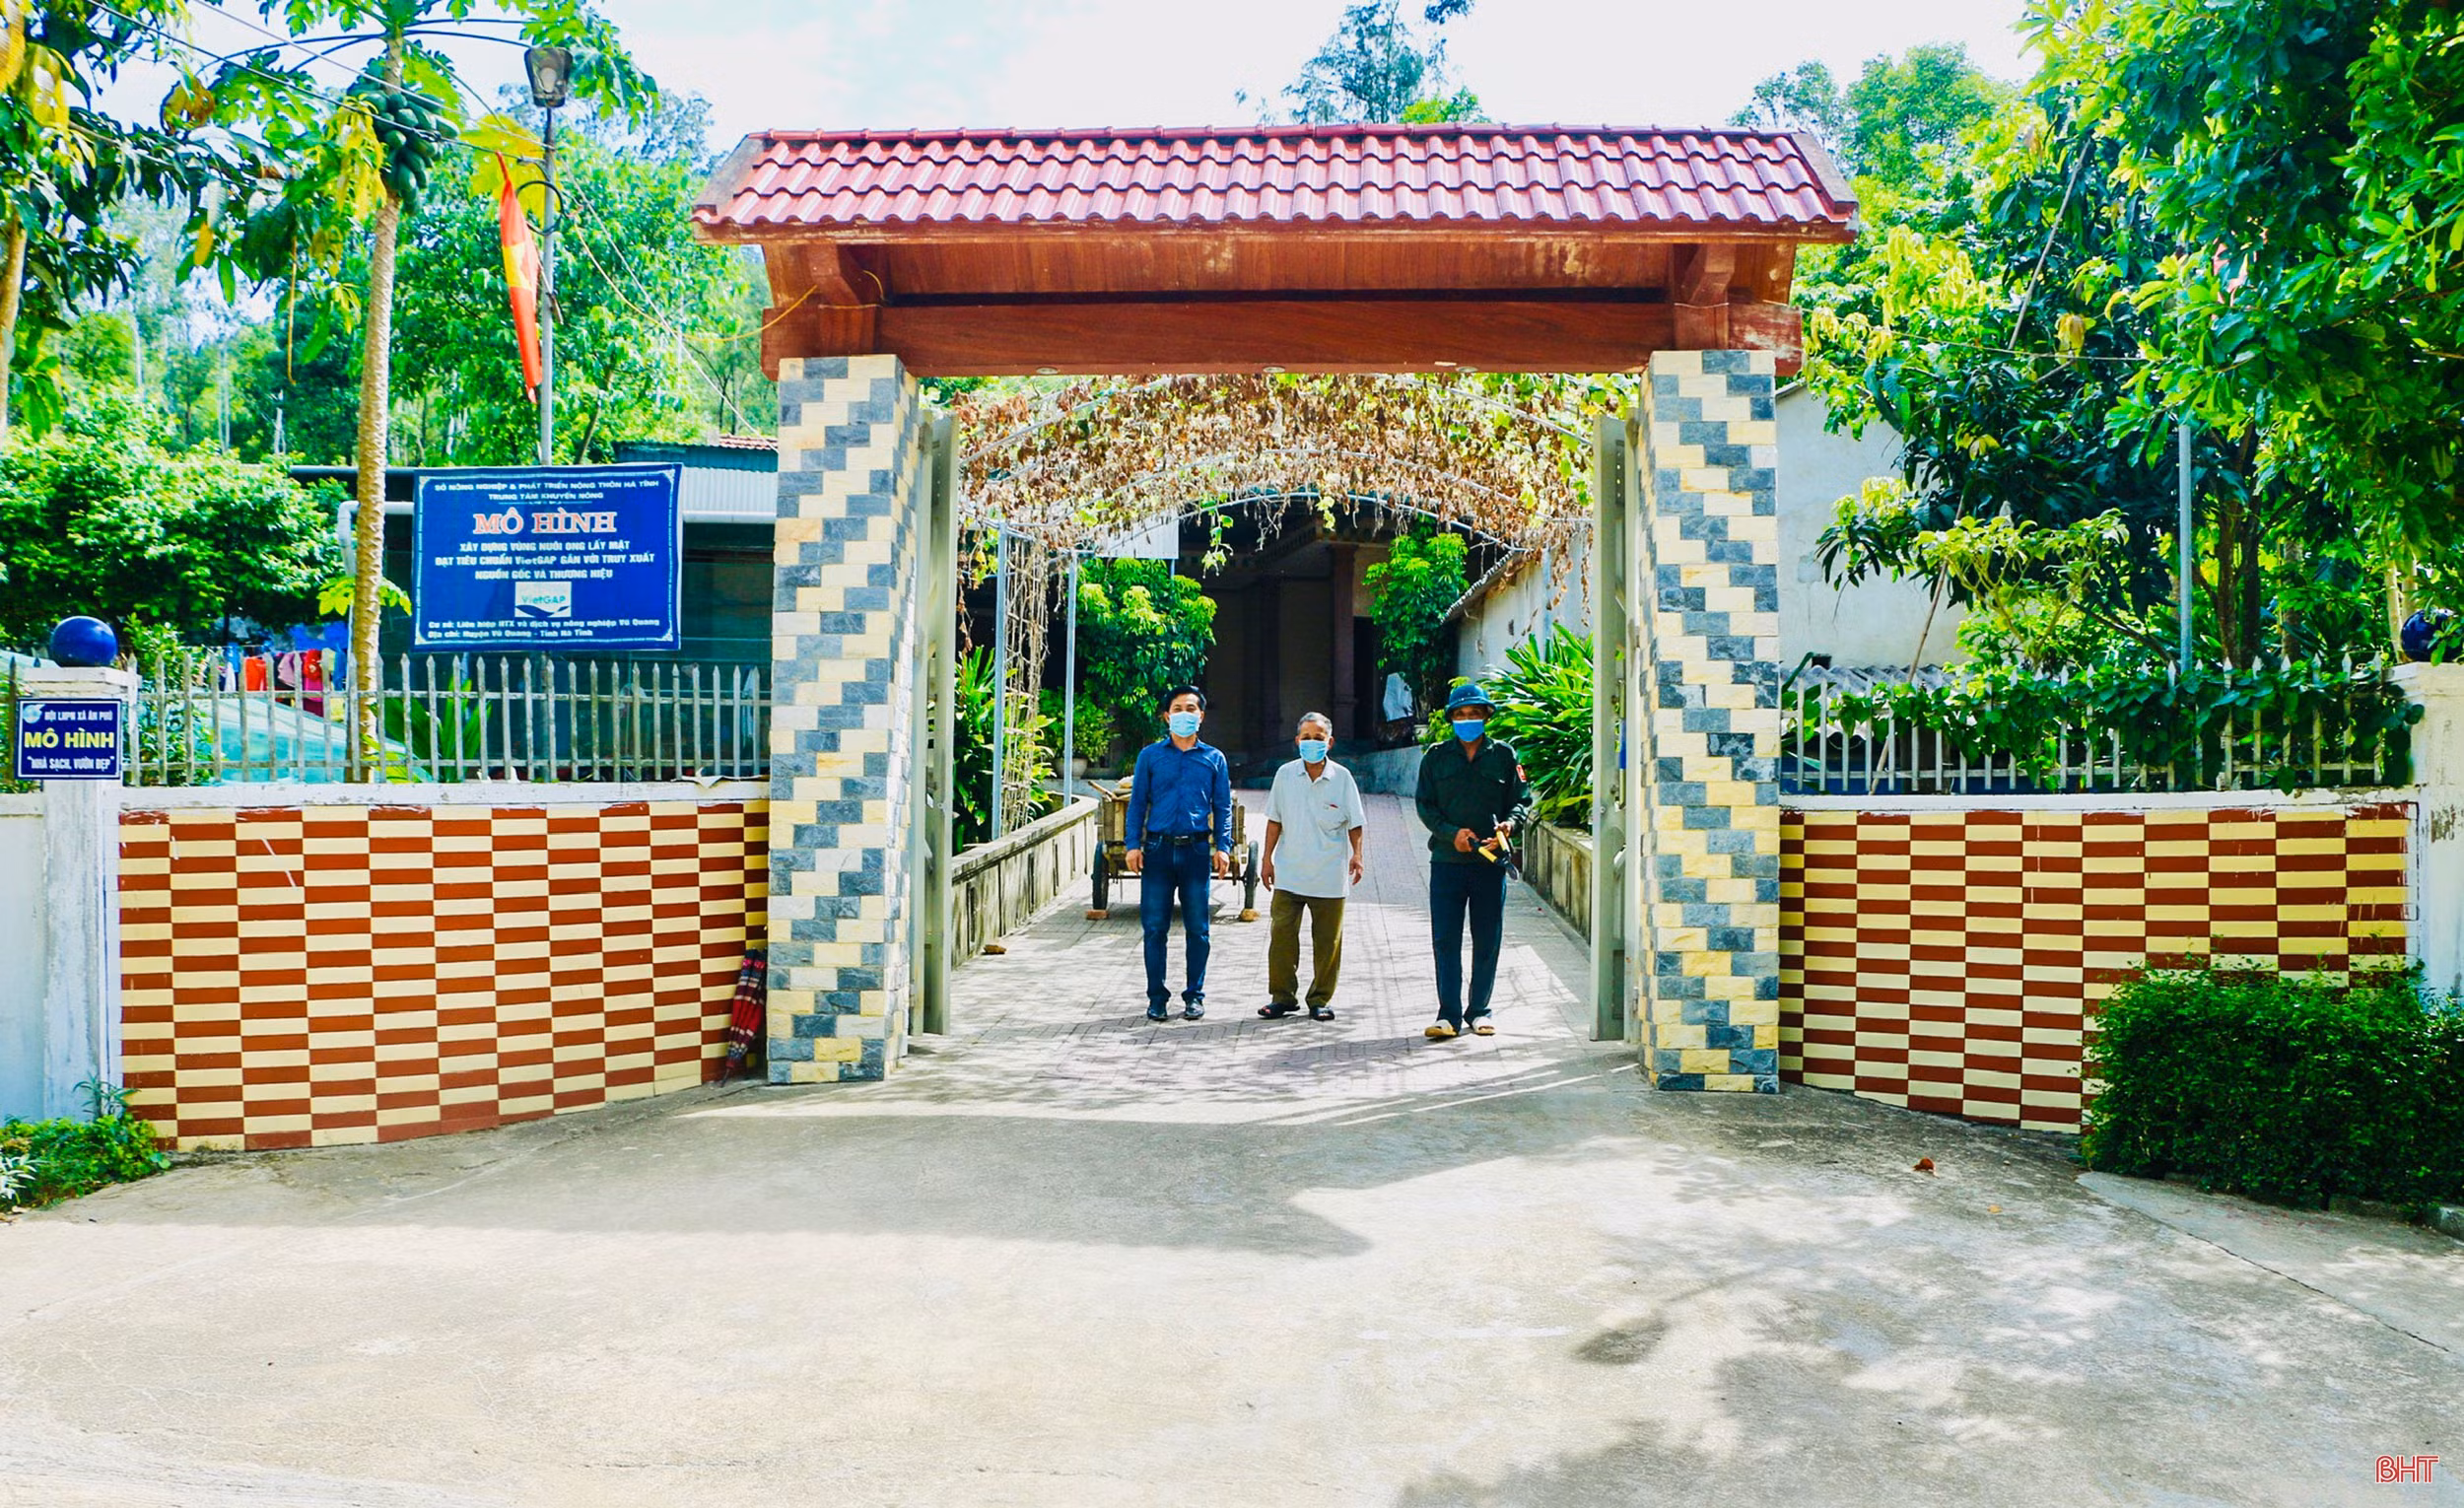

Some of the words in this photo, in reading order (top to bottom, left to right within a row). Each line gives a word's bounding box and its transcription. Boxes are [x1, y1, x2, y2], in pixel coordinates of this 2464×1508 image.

[473, 507, 524, 534] MÔ
[531, 507, 617, 533] HÌNH
[460, 542, 479, 551] XÂY
[481, 542, 508, 553] DỰNG
[511, 541, 536, 551] VÙNG
[539, 541, 562, 551] NUÔI
[565, 542, 585, 550] ONG
[588, 539, 606, 550] LẤY
[609, 540, 630, 551] MẬT
[435, 557, 454, 567] ĐẠT
[456, 555, 477, 565] TIÊU
[515, 556, 557, 565] VietGAP
[602, 554, 626, 563] TRUY
[629, 550, 654, 562] XUẤT
[512, 568, 531, 579] GỐC
[534, 569, 546, 579] VÀ
[590, 568, 613, 579] HIỆU
[520, 595, 567, 604] VietGAP
[24, 727, 59, 748] MÔ
[65, 727, 115, 748] HÌNH
